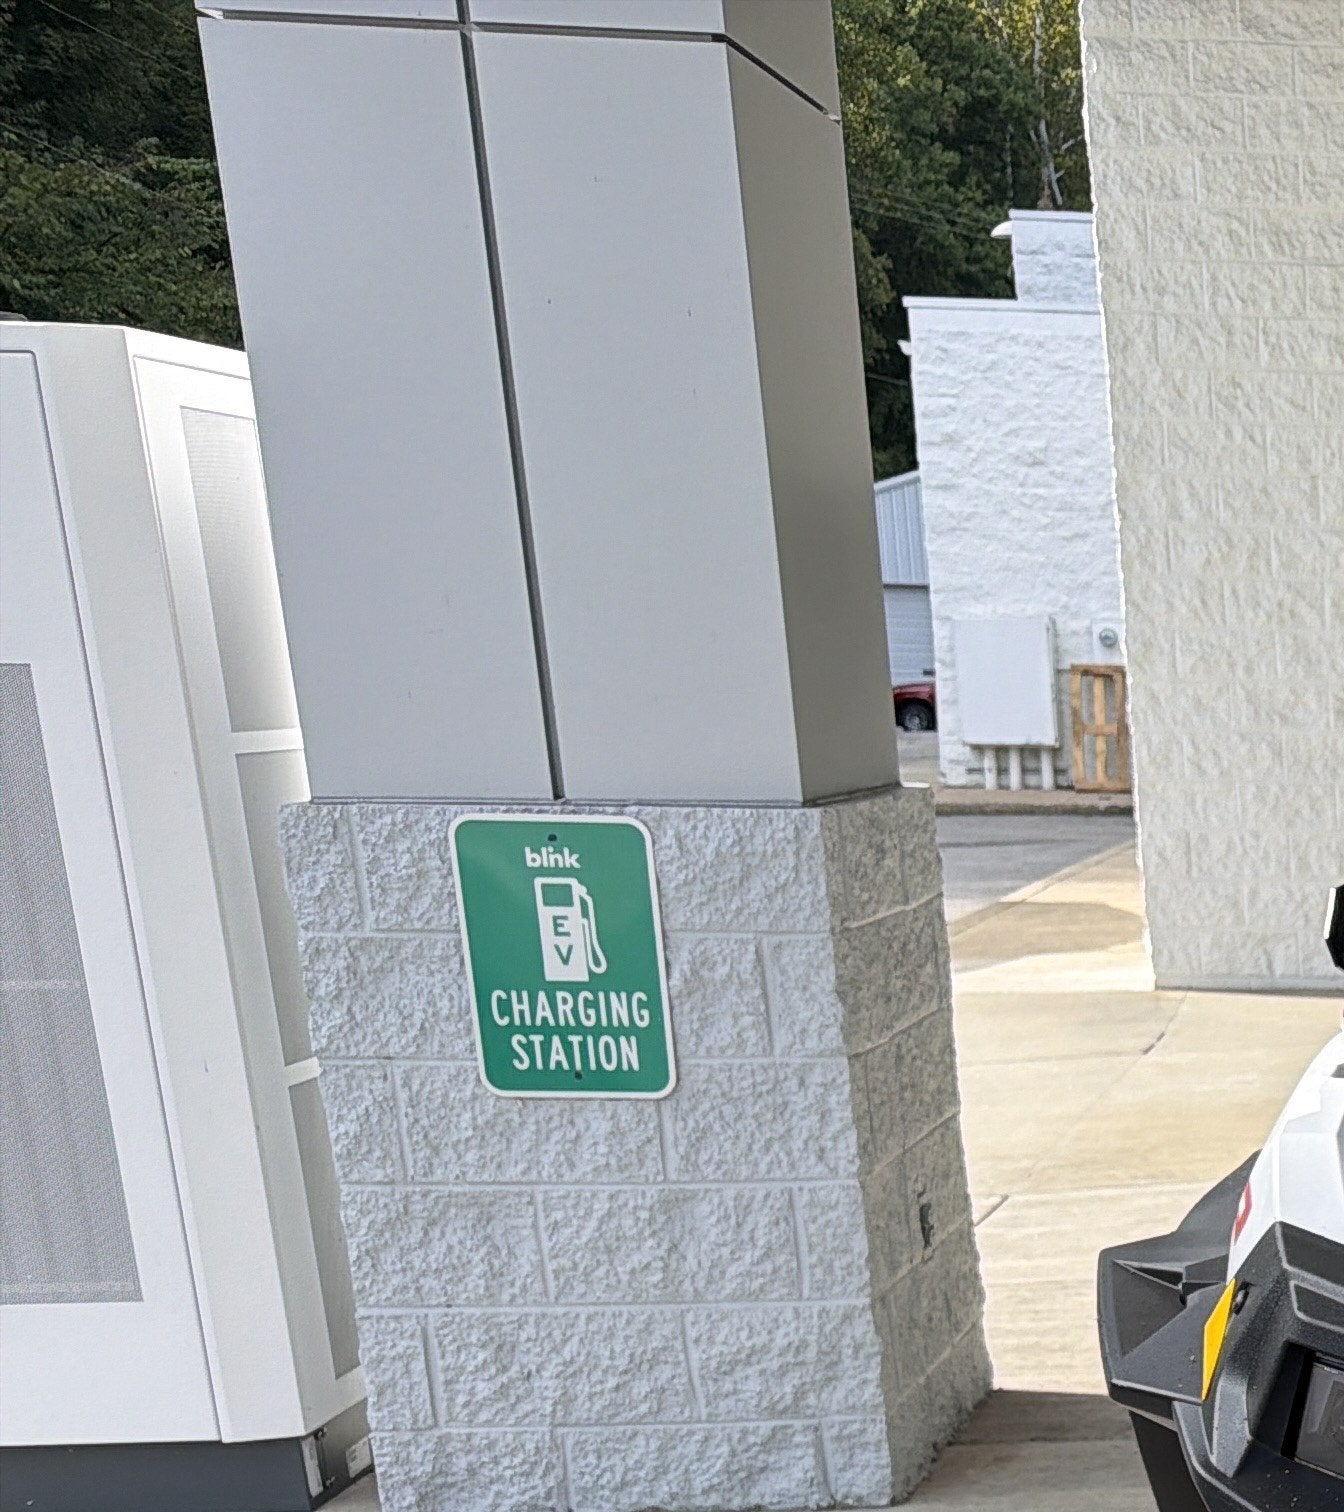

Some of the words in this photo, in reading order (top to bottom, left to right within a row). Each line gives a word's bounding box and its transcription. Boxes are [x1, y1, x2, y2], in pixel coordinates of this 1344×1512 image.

[525, 847, 581, 868] blink
[552, 915, 571, 937] E
[554, 944, 574, 966] V
[491, 989, 651, 1028] CHARGING
[511, 1034, 640, 1072] STATION
